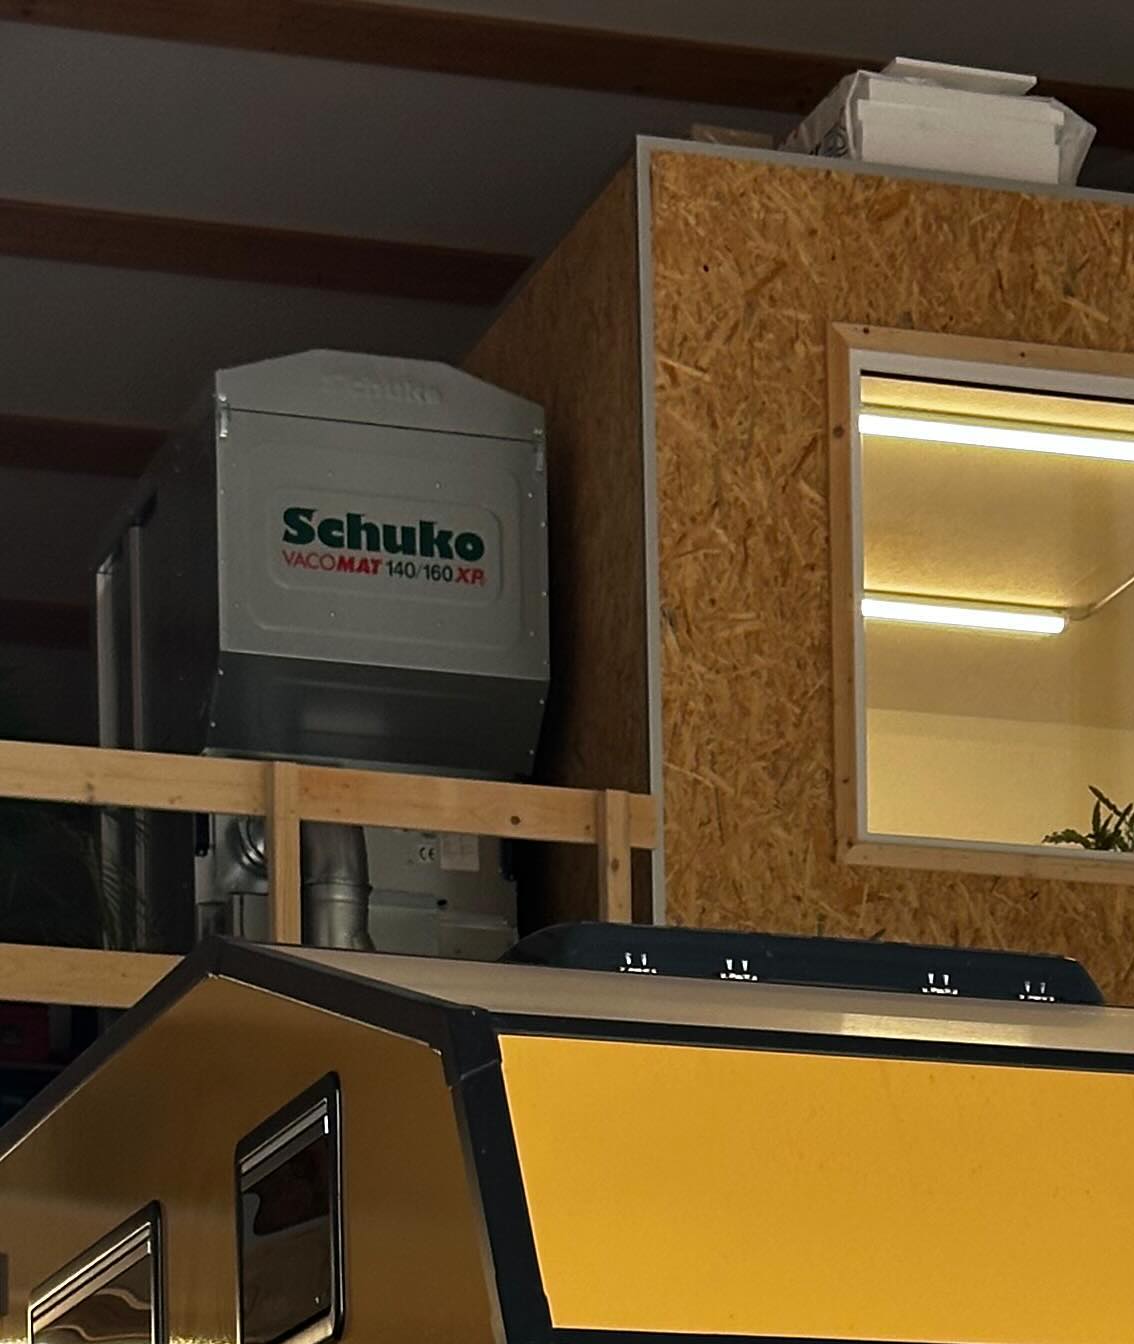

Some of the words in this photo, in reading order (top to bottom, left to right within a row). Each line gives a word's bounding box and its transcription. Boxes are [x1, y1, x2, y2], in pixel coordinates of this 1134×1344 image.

[281, 507, 485, 562] Schuko
[281, 549, 383, 577] VACOMAT
[386, 559, 454, 583] 140/160
